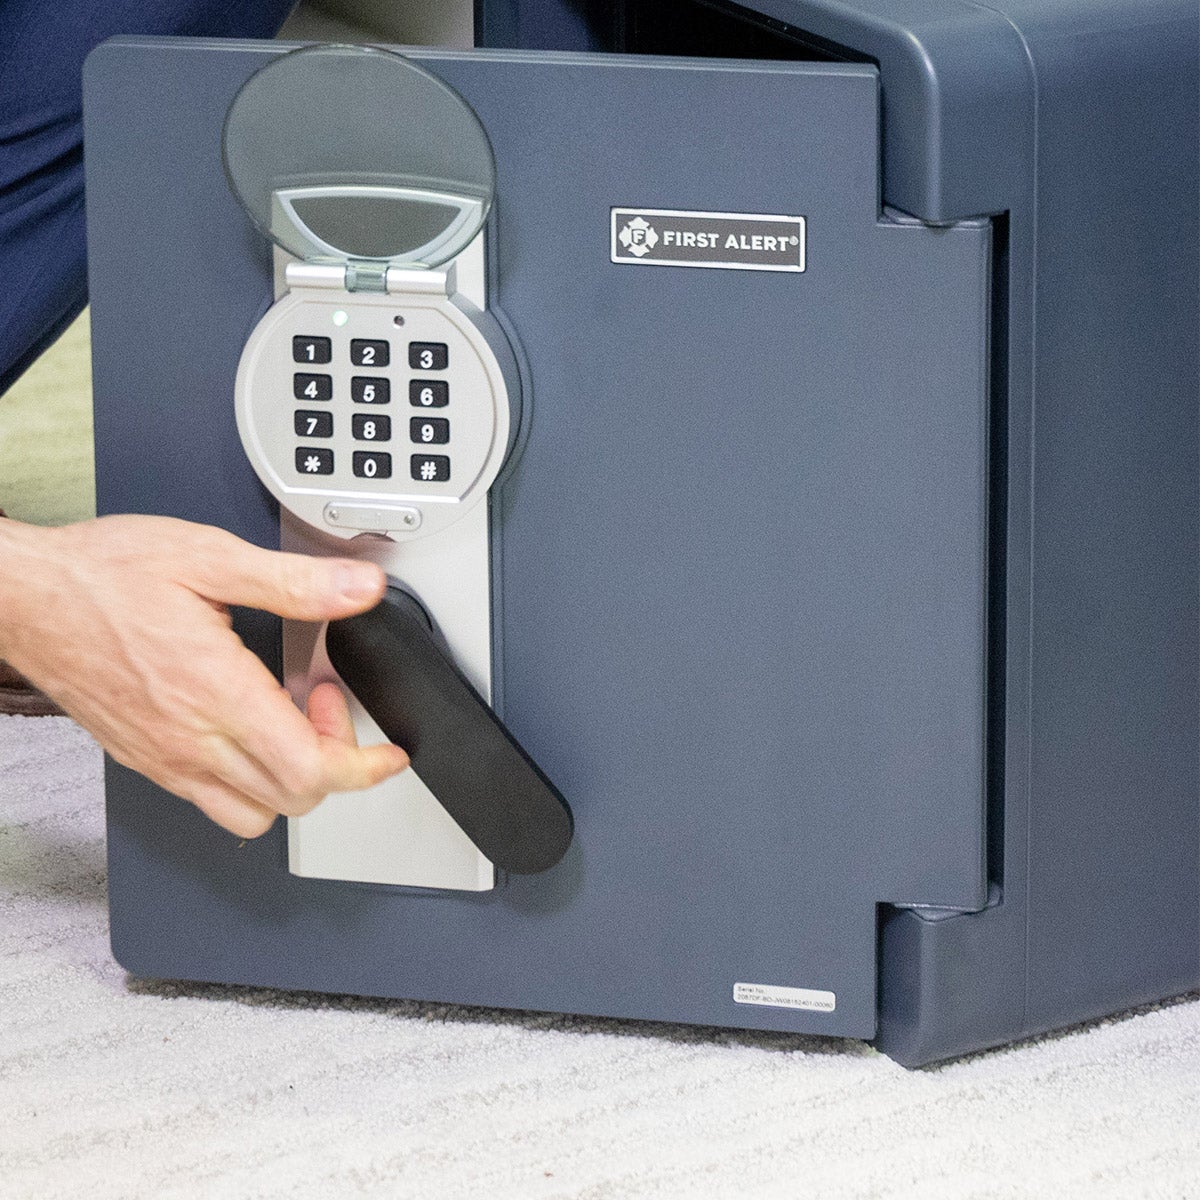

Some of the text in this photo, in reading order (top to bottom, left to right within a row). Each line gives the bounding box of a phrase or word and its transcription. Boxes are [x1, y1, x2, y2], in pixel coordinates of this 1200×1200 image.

[663, 231, 719, 248] FIRST
[306, 344, 434, 368] 1 2 3
[304, 381, 434, 406] 4 5 6
[306, 417, 434, 442] 7 8 9
[363, 459, 377, 477] 0
[420, 462, 437, 480] #
